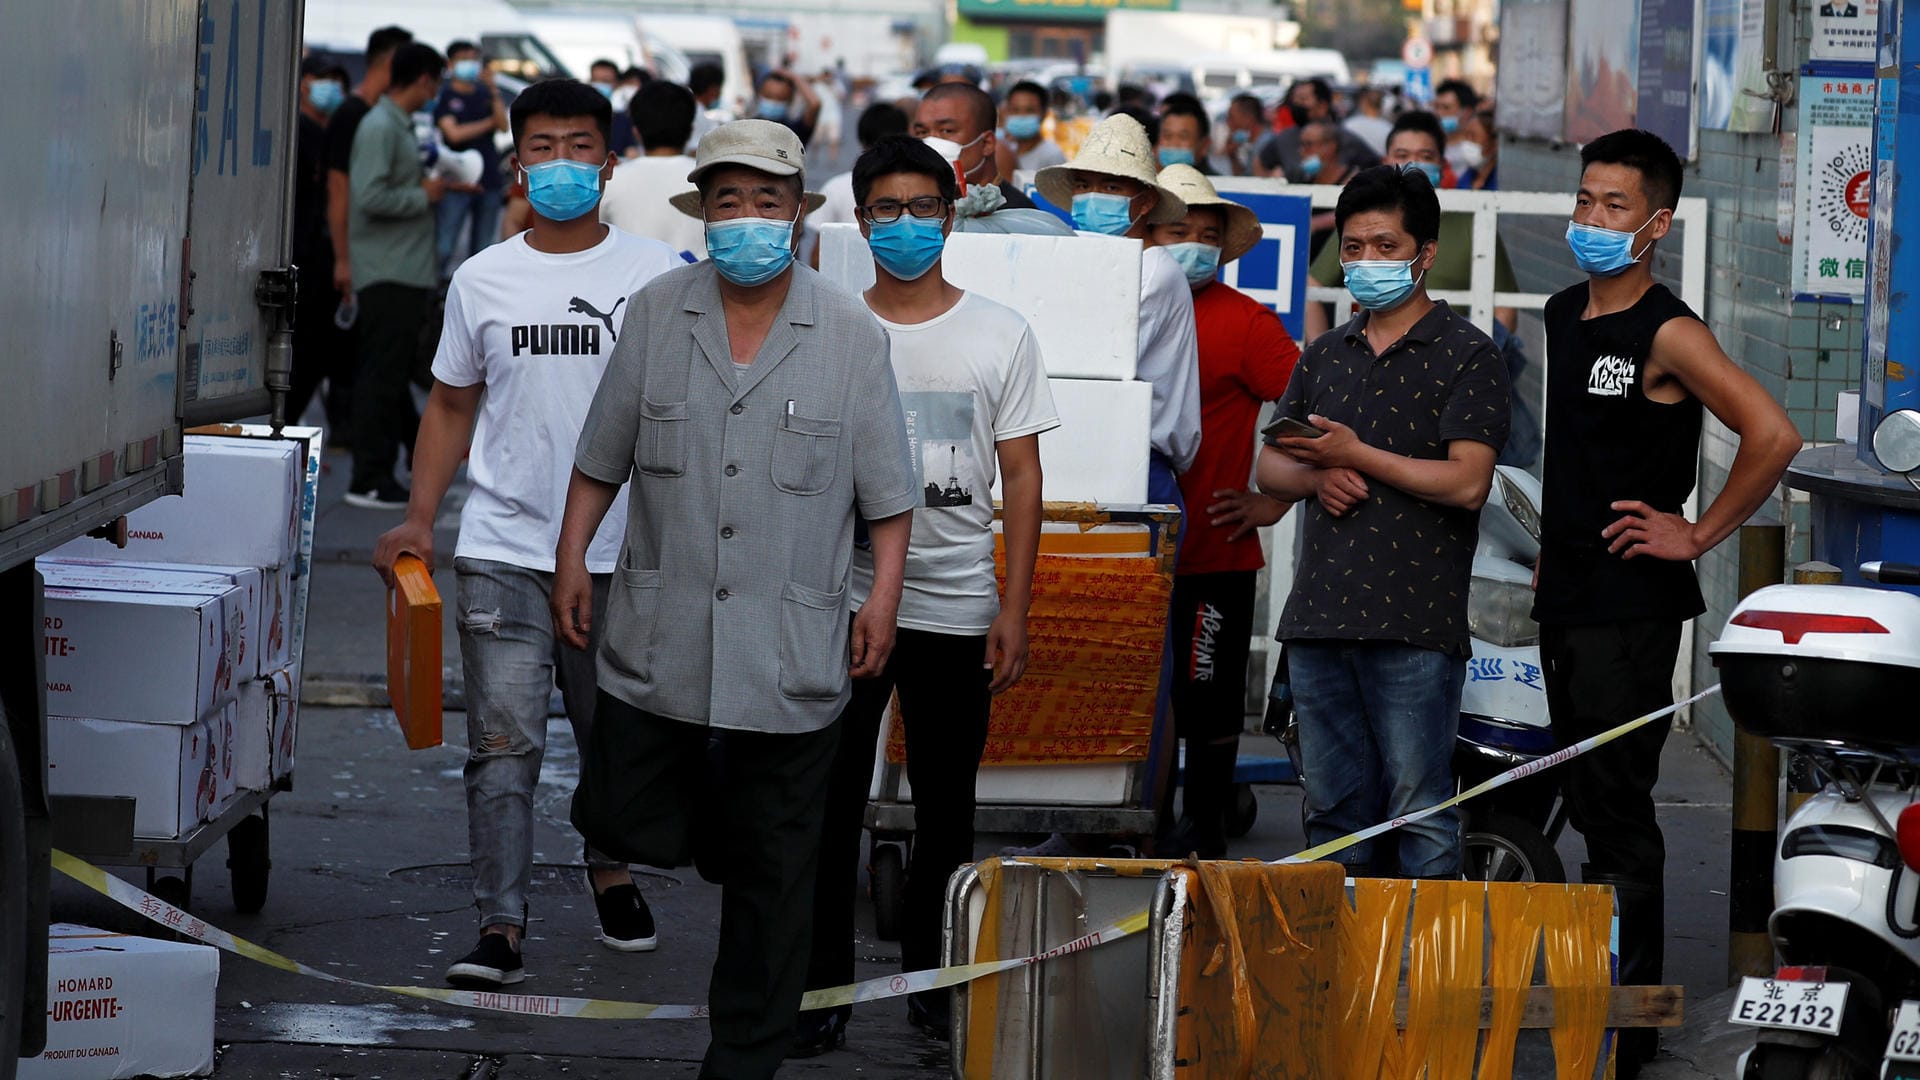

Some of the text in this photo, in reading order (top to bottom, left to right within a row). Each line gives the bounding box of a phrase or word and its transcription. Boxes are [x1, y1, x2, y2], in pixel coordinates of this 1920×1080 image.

[1819, 257, 1866, 279] 微信
[511, 324, 601, 357] PUMA
[127, 530, 164, 541] CANADA
[1469, 658, 1543, 691] 巡逻
[58, 977, 113, 993] HOMARD
[1765, 985, 1818, 1001] 北京
[47, 998, 124, 1022] -URGENTE-
[1739, 1000, 1834, 1028] E22132
[44, 1046, 119, 1061] PRODUIT DU CANADA
